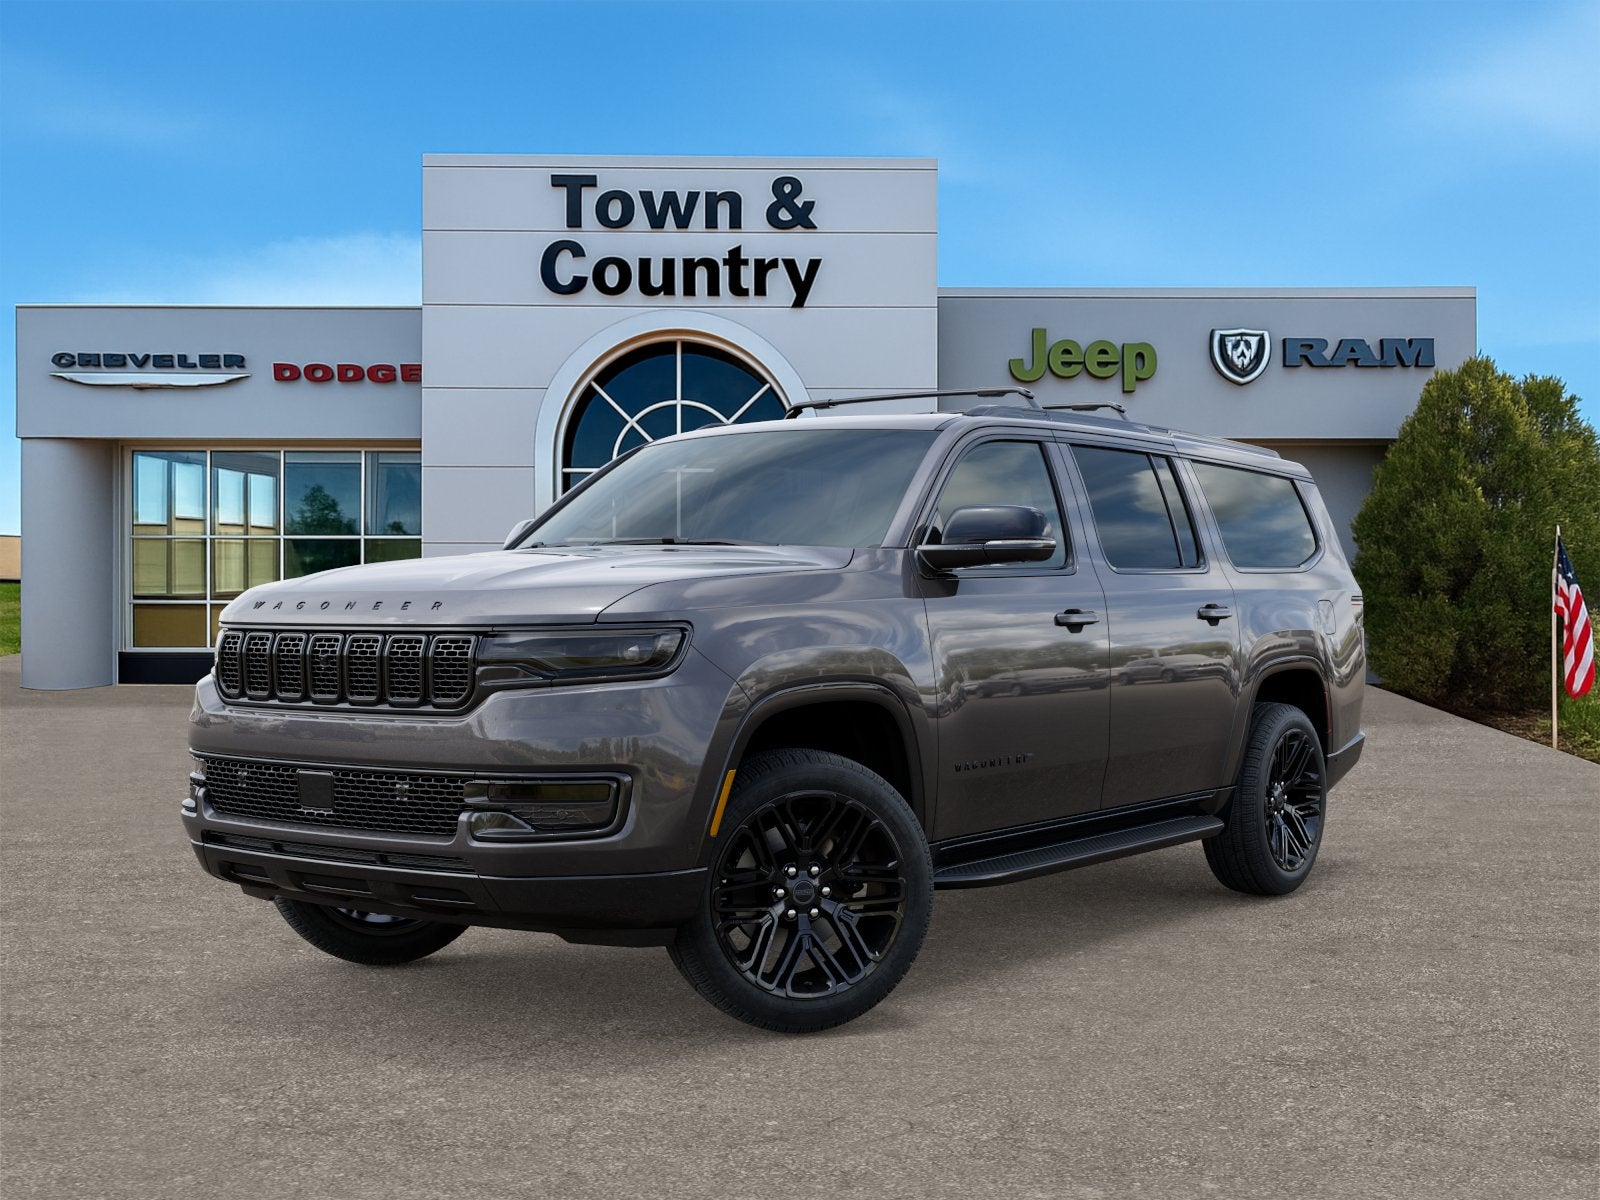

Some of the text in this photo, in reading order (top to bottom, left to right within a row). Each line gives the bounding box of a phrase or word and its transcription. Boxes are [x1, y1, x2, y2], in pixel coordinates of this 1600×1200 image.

[551, 174, 818, 230] Town &
[540, 239, 823, 308] Country
[273, 362, 422, 383] DODGE
[1009, 328, 1157, 393] Jeep
[1282, 337, 1436, 367] RAM
[253, 601, 442, 611] WAGONEER
